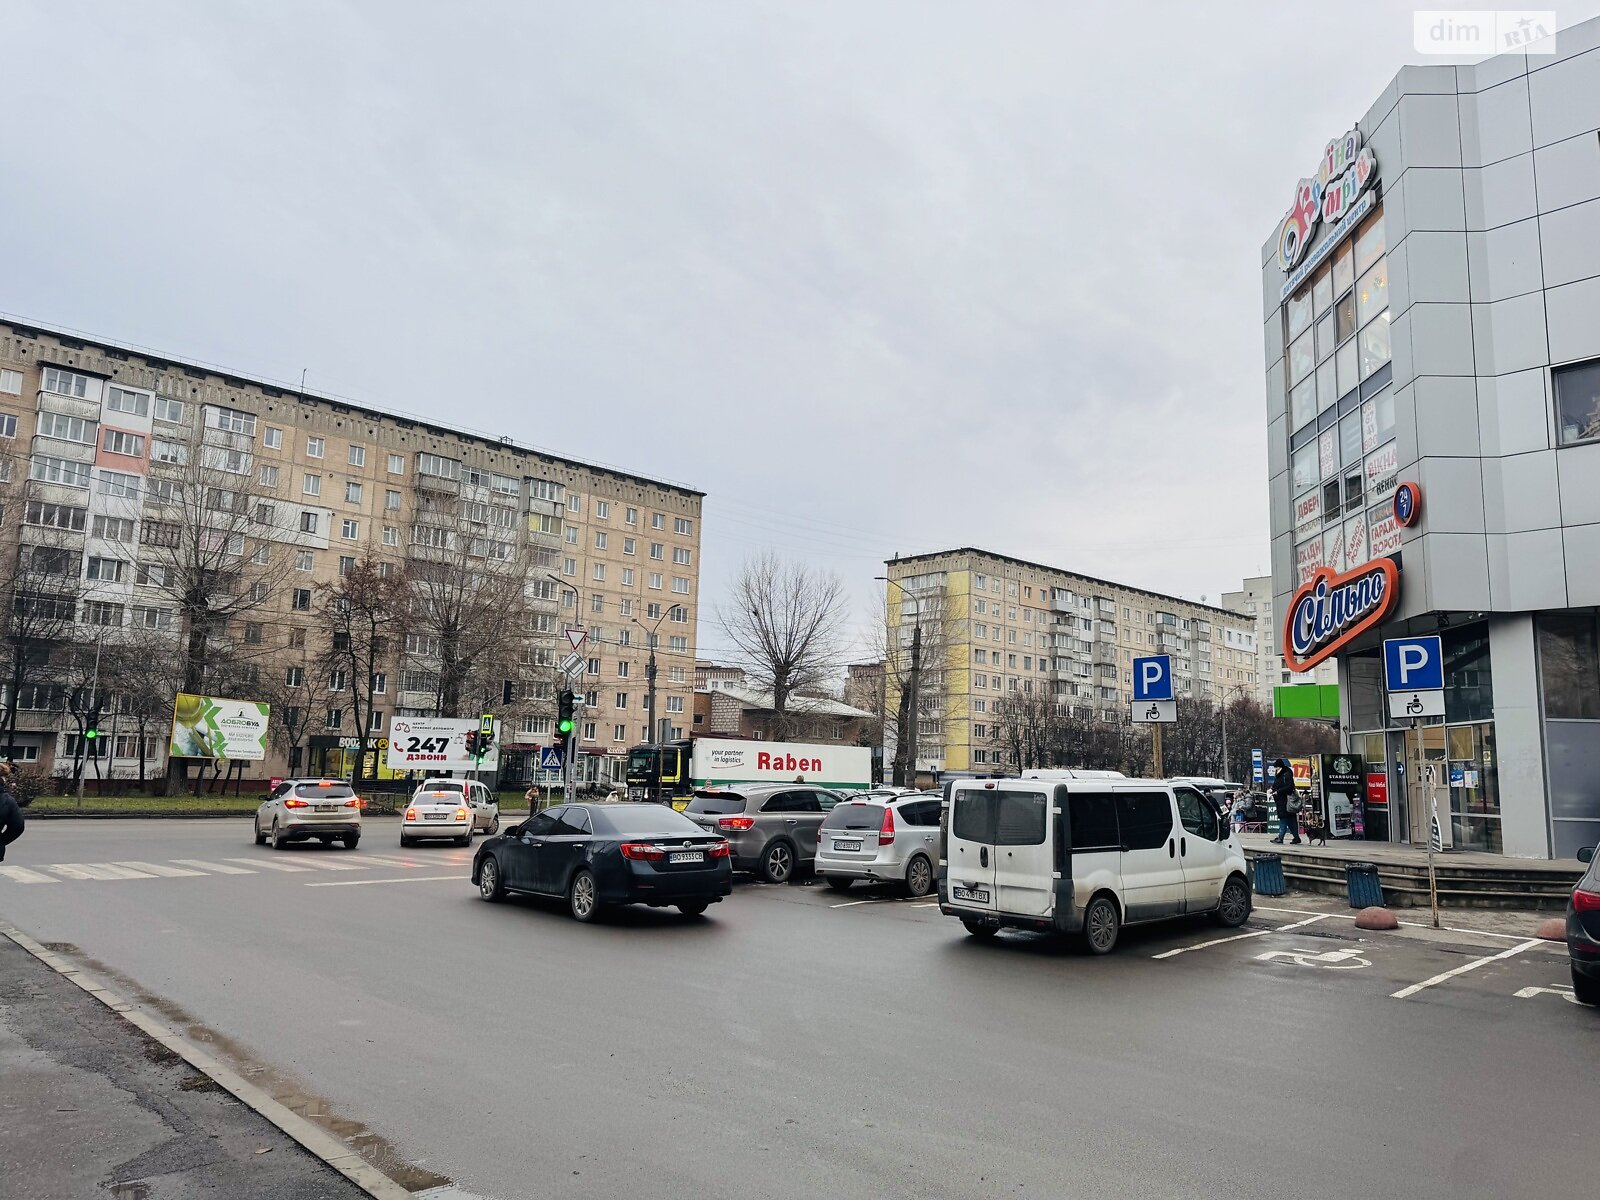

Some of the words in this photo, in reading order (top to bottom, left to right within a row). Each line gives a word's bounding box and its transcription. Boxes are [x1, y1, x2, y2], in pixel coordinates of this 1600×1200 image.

[1399, 489, 1408, 503] 24
[1297, 493, 1319, 521] ДВЕРІ
[1401, 504, 1408, 517] 7
[1291, 571, 1385, 655] Сільпо
[1400, 645, 1428, 684] P
[1142, 662, 1162, 695] P
[407, 737, 450, 753] 247
[406, 753, 447, 761] ДЗВОНИ
[720, 756, 742, 764] logistics
[757, 752, 822, 772] Raben
